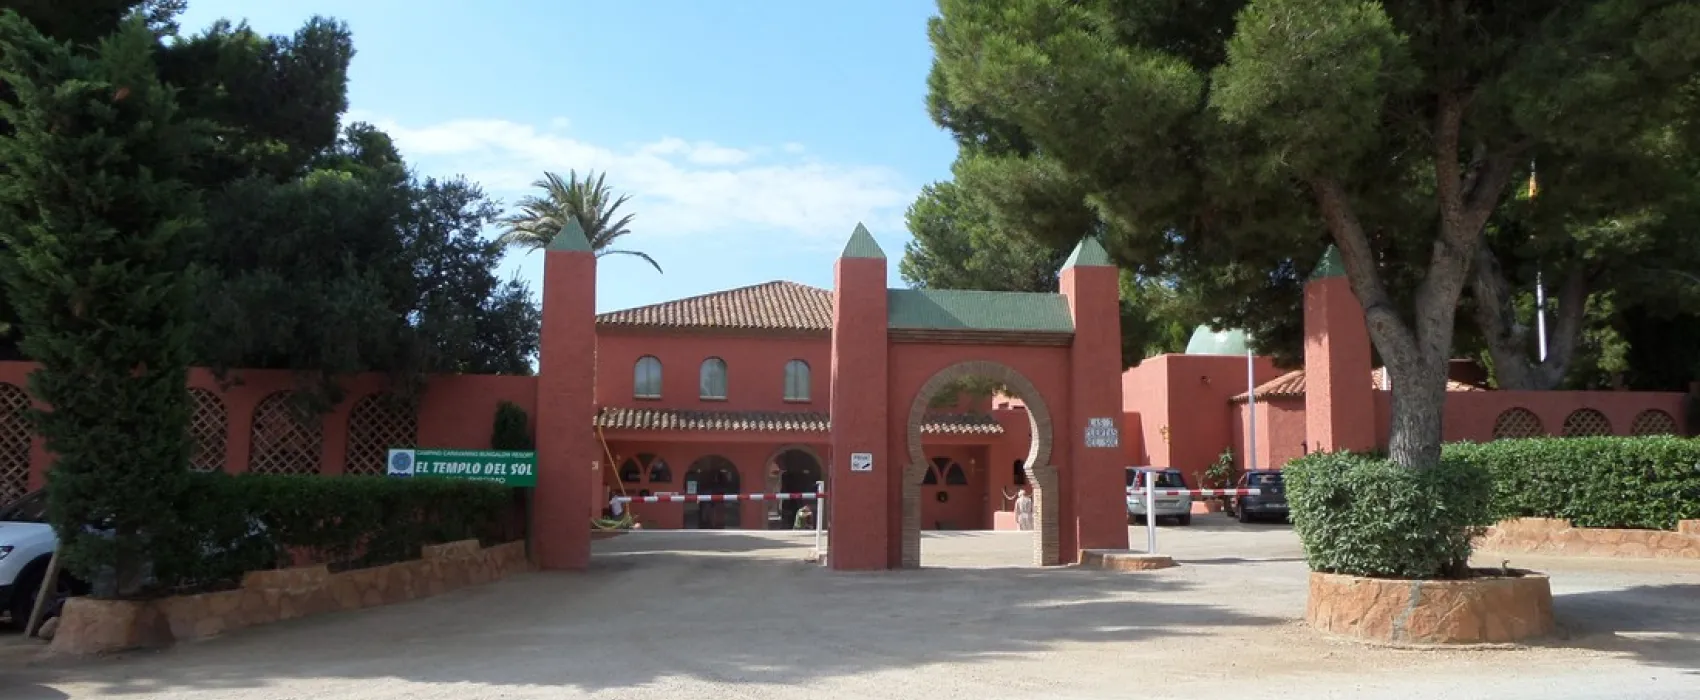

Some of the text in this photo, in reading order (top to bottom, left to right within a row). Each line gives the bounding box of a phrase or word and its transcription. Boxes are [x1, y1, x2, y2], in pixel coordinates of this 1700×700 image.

[416, 461, 533, 476] EL TEMPLO DEL SOL
